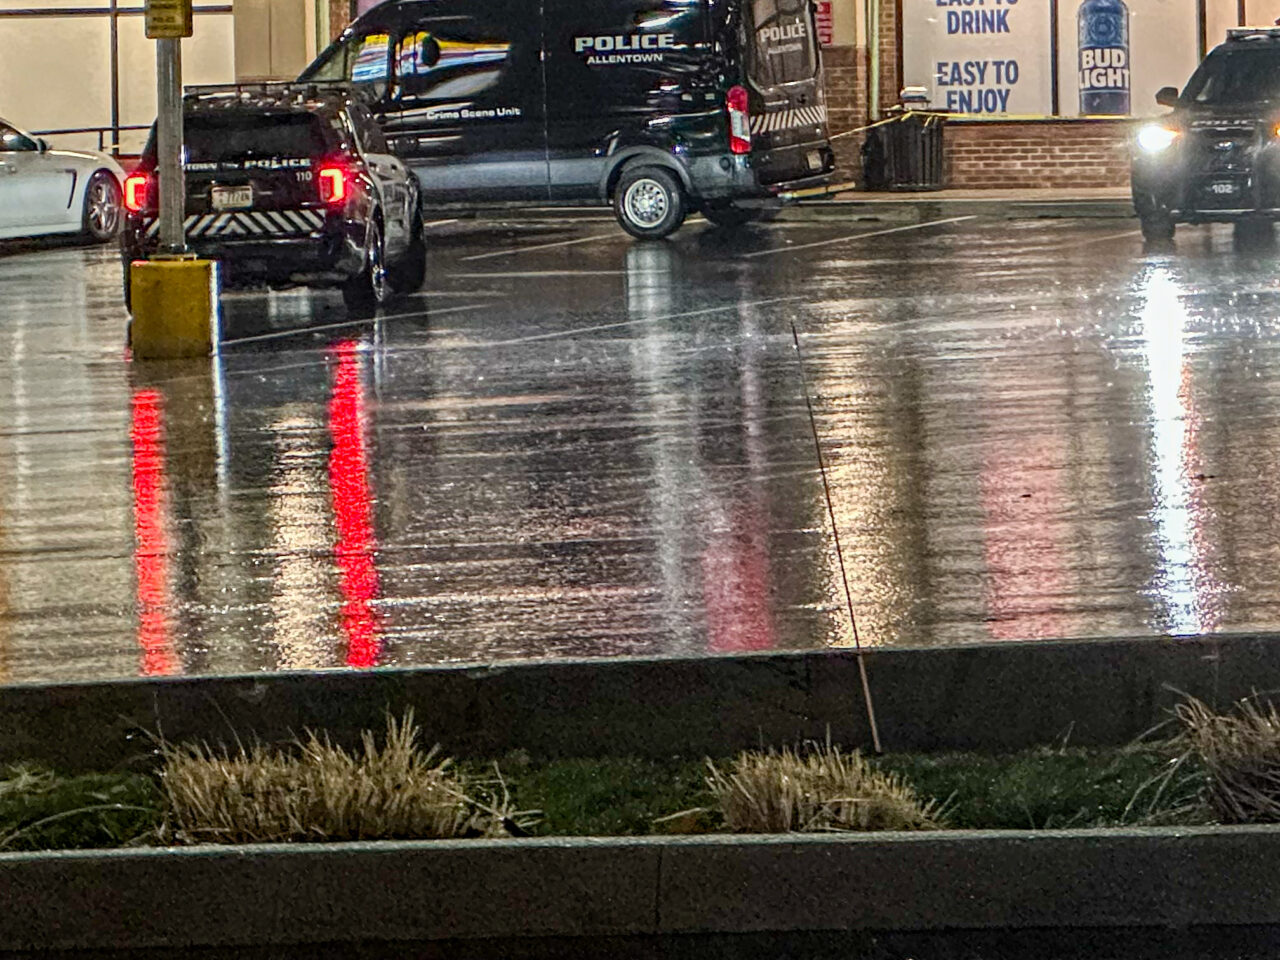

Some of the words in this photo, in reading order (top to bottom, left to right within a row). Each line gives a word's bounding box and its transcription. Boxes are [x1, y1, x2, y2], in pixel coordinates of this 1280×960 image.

[947, 8, 1010, 34] DRINK
[760, 22, 806, 42] POLICE
[575, 33, 674, 52] POLICE
[587, 53, 663, 65] ALLENTOWN
[1082, 49, 1126, 68] BUD
[937, 61, 988, 86] EASY
[992, 60, 1019, 85] TO
[1079, 69, 1130, 89] LIGHT
[946, 89, 1011, 113] ENJOY
[426, 110, 459, 120] Crime
[461, 109, 495, 118] Scene
[496, 107, 521, 116] Unit
[244, 158, 311, 168] POLICE
[296, 171, 312, 181] 110
[1212, 184, 1233, 194] 102
